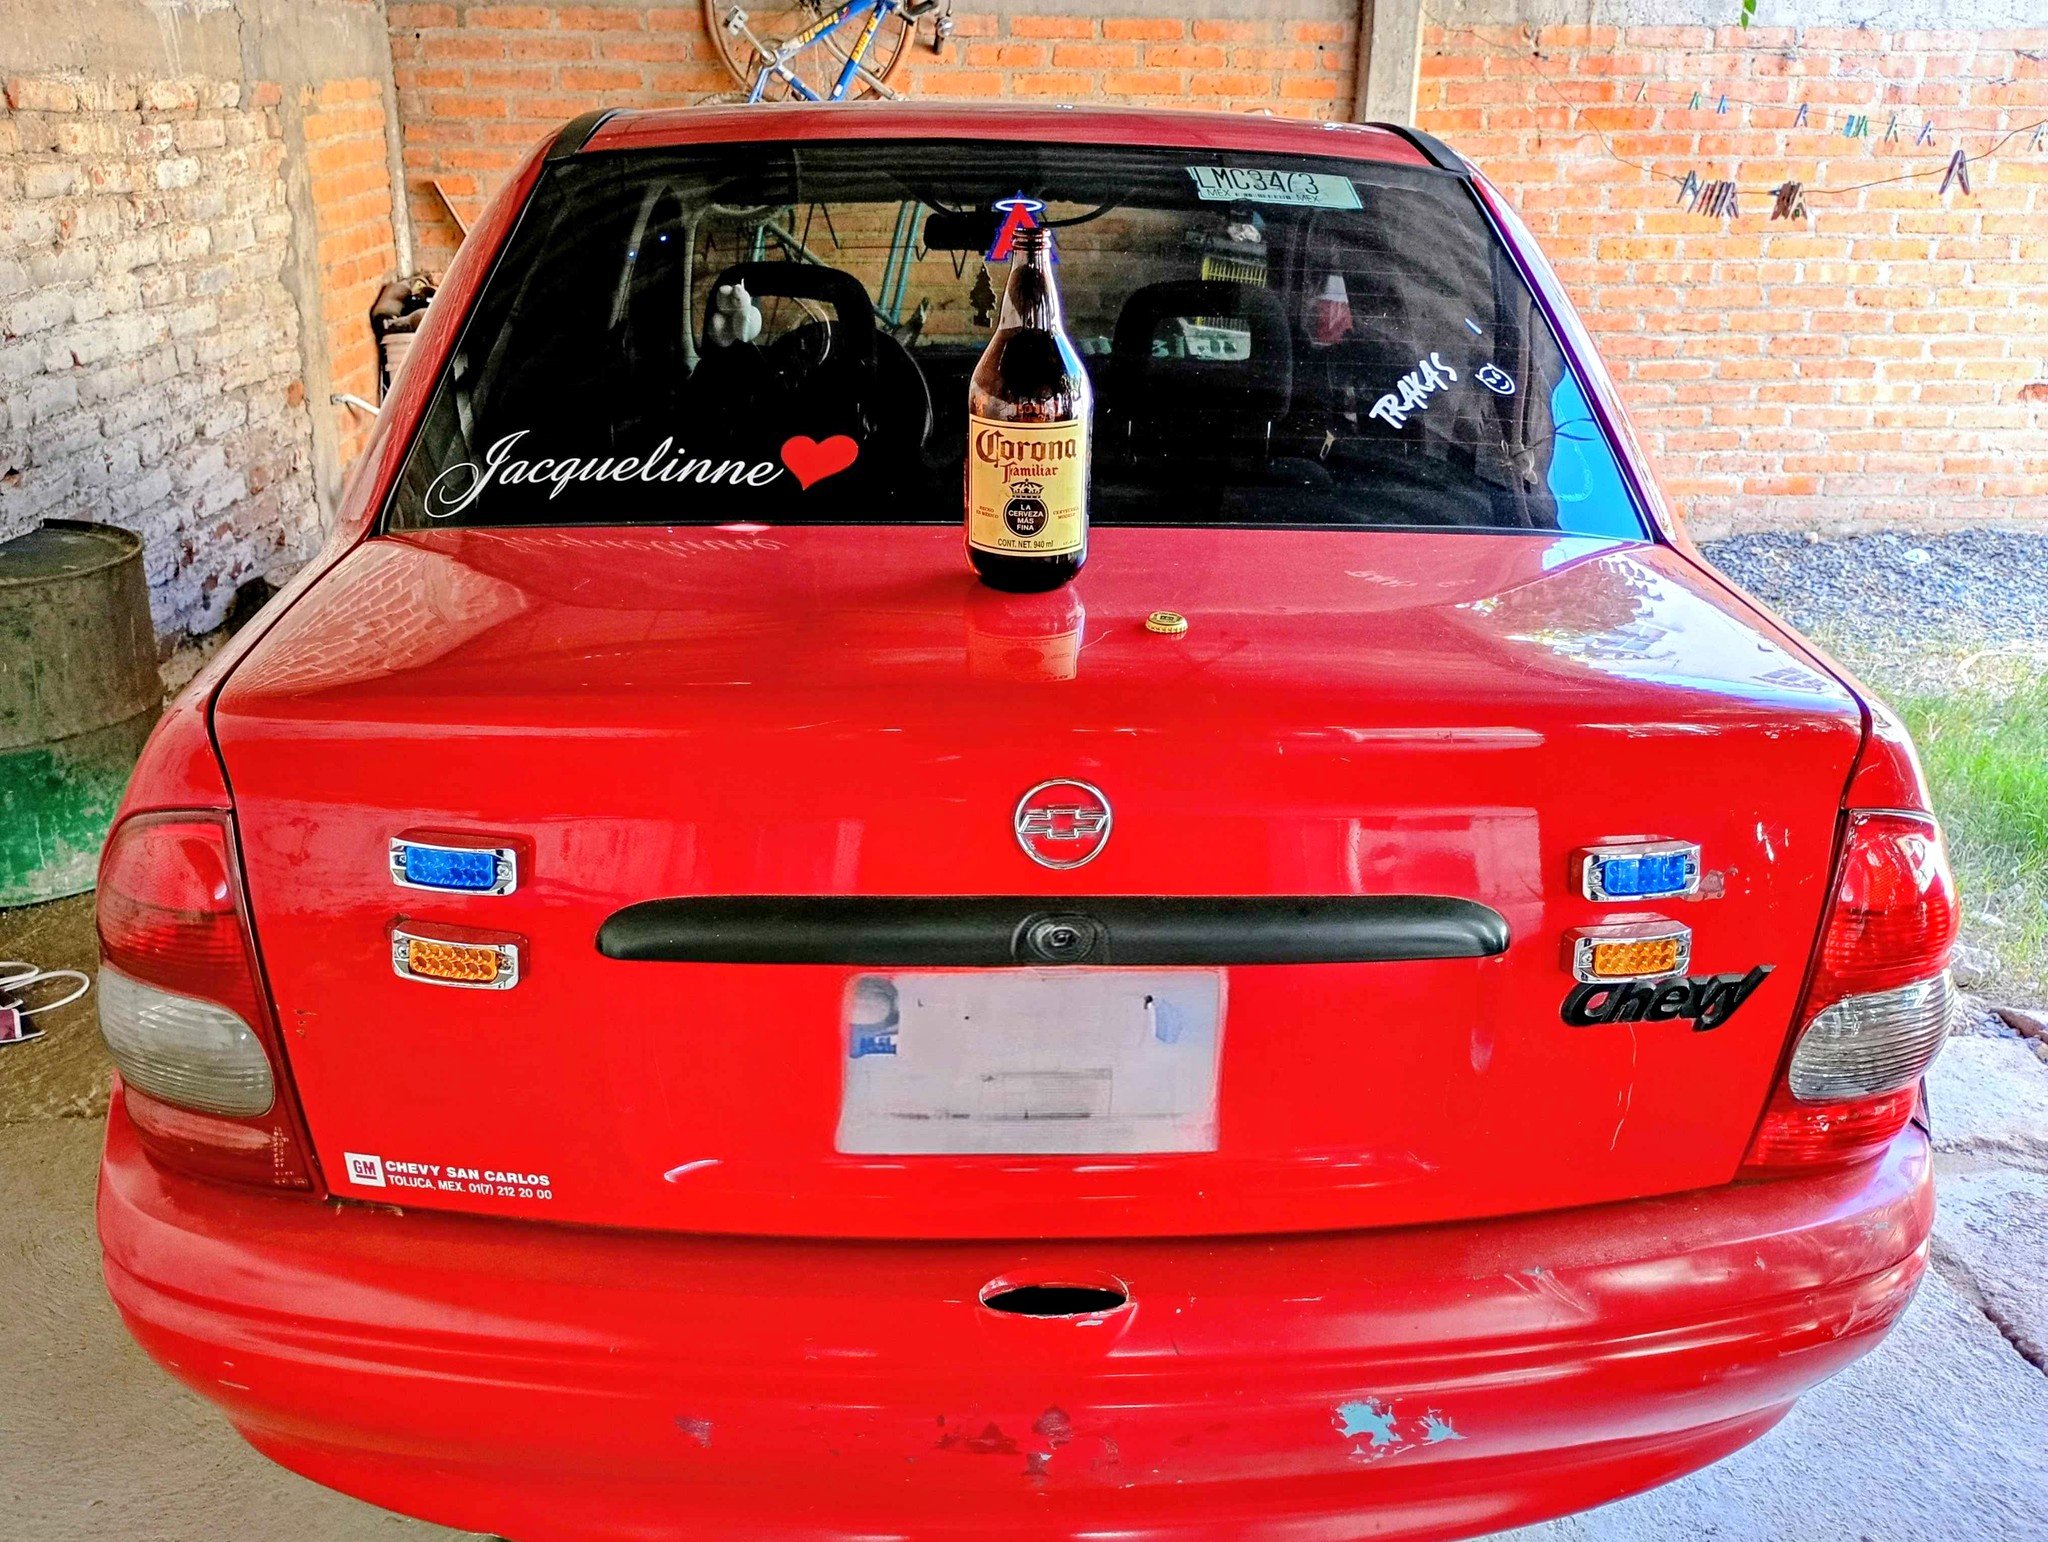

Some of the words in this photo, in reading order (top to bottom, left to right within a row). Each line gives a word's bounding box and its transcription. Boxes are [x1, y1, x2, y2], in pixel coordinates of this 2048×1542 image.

[1206, 188, 1232, 198] MEX
[975, 429, 1077, 468] Corona
[424, 430, 785, 518] Jacquelinne
[1000, 461, 1059, 484] Familiar
[997, 538, 1017, 548] CONT.
[1018, 540, 1032, 549] NET.
[1033, 540, 1045, 549] 940
[1045, 540, 1054, 548] ml
[1560, 965, 1776, 1032] Chevy
[353, 1159, 377, 1176] GM
[385, 1160, 440, 1176] CHEVY
[446, 1166, 480, 1180] SAN
[484, 1170, 551, 1186] CARLOS
[387, 1174, 437, 1190] TOLUCA,
[437, 1180, 466, 1192] MEX.
[468, 1183, 494, 1196] 01(7)
[496, 1185, 516, 1197] 212
[518, 1187, 534, 1198] 20
[536, 1189, 553, 1200] 00
